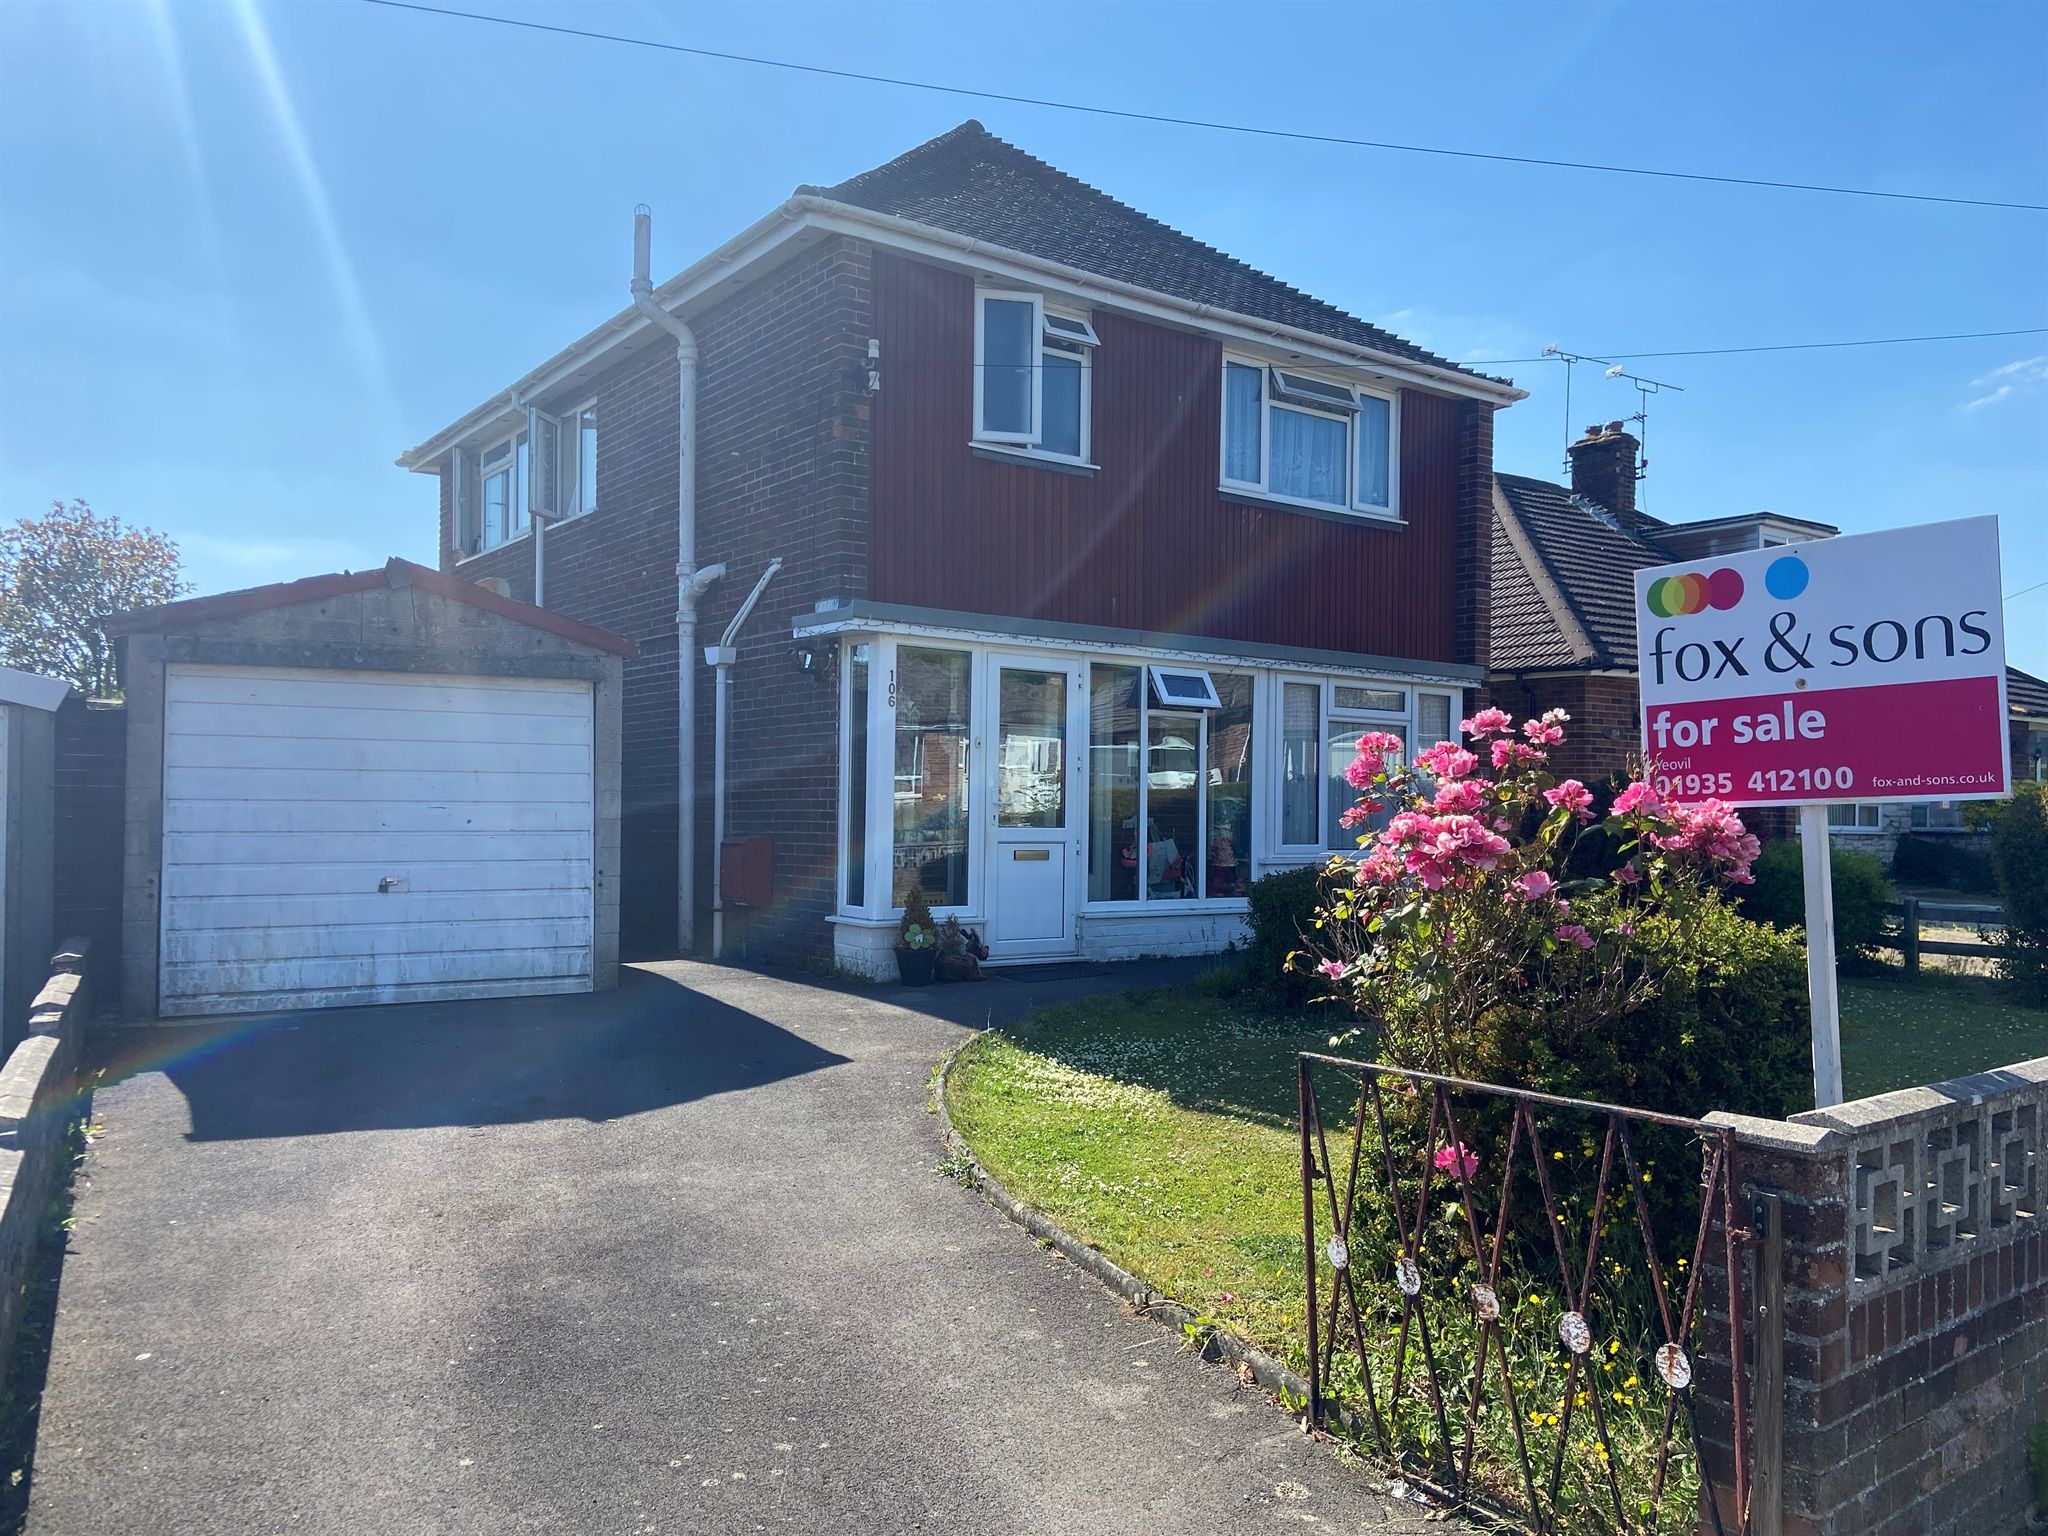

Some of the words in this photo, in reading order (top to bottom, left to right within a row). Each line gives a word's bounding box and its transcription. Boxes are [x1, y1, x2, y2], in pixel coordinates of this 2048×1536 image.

[1649, 627, 1749, 684] fox
[1764, 611, 1815, 673] &
[1829, 610, 1991, 667] sons
[888, 670, 896, 707] 106
[1653, 711, 1718, 748] for
[1732, 700, 1826, 744] sale
[1656, 757, 1691, 770] Yeovil
[1873, 771, 1996, 788] fox-and-sons.co.uk
[1656, 773, 1733, 797] 01935
[1747, 766, 1854, 793] 412100
